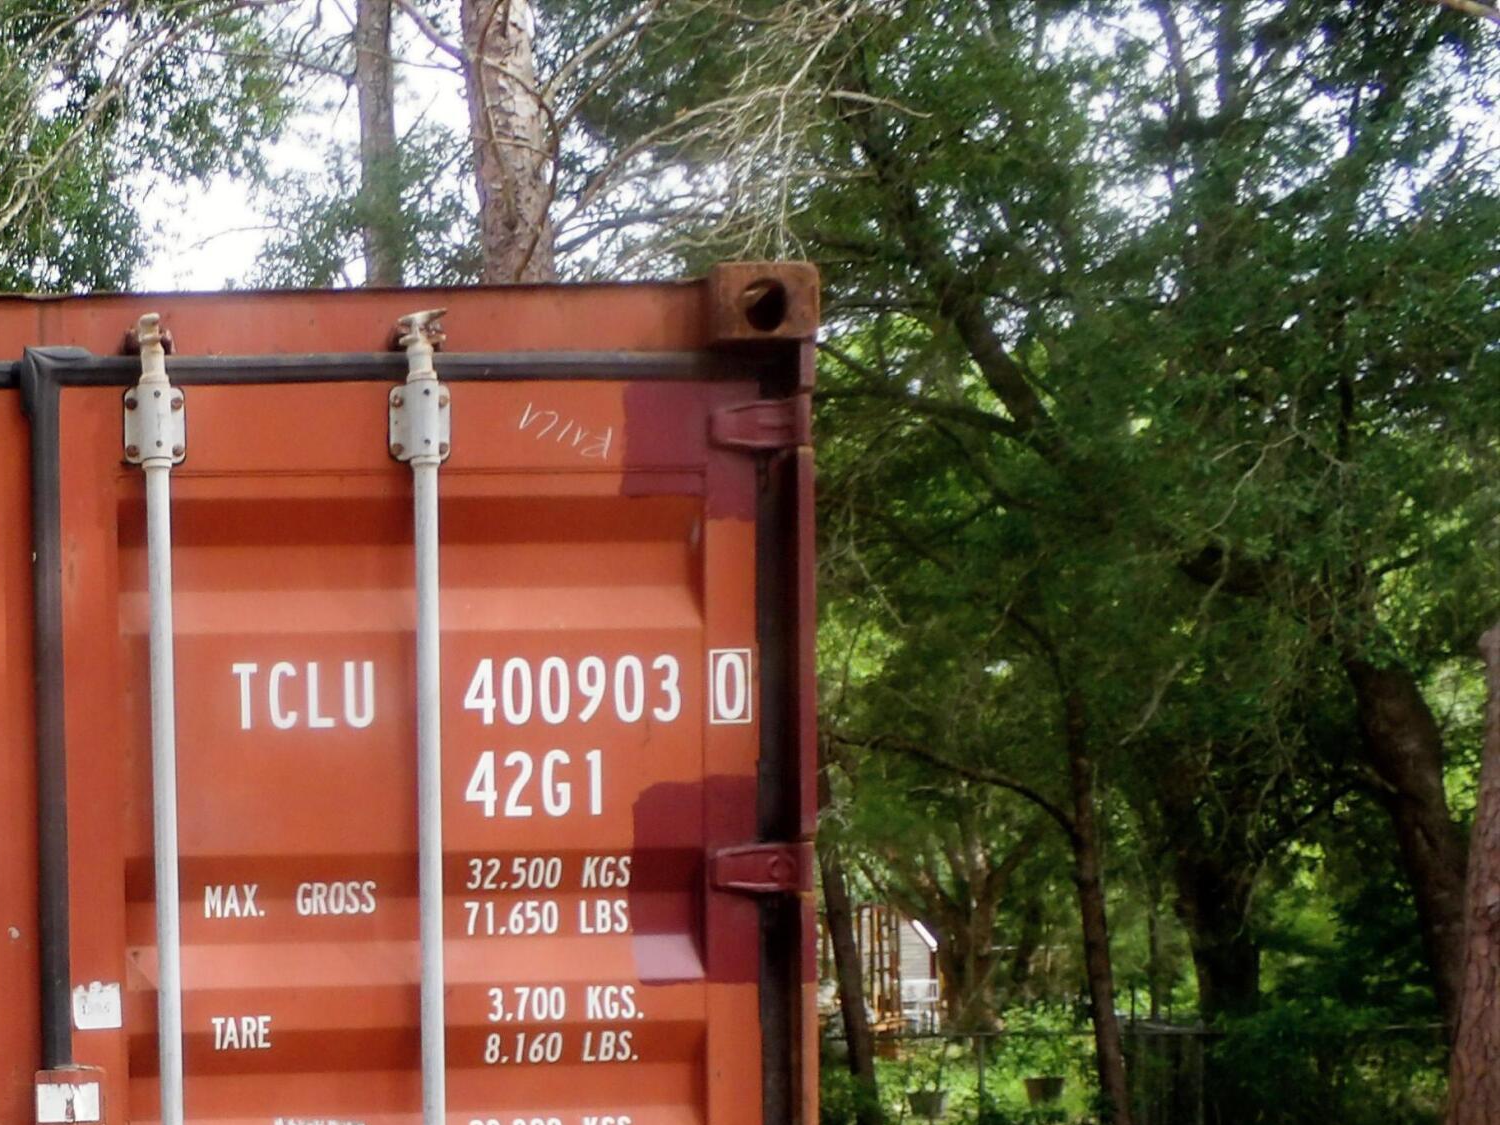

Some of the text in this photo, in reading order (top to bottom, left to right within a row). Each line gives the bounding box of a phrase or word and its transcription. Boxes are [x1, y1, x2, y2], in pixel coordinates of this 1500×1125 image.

[232, 652, 746, 730] TCLU 400903 0
[465, 749, 603, 818] 42G1
[581, 855, 632, 889] KGS
[204, 880, 377, 919] MAX. GROSS
[579, 899, 629, 934] LBS
[587, 985, 645, 1021] KGS.
[211, 1015, 272, 1051] TARE
[581, 1029, 639, 1062] LBS.
